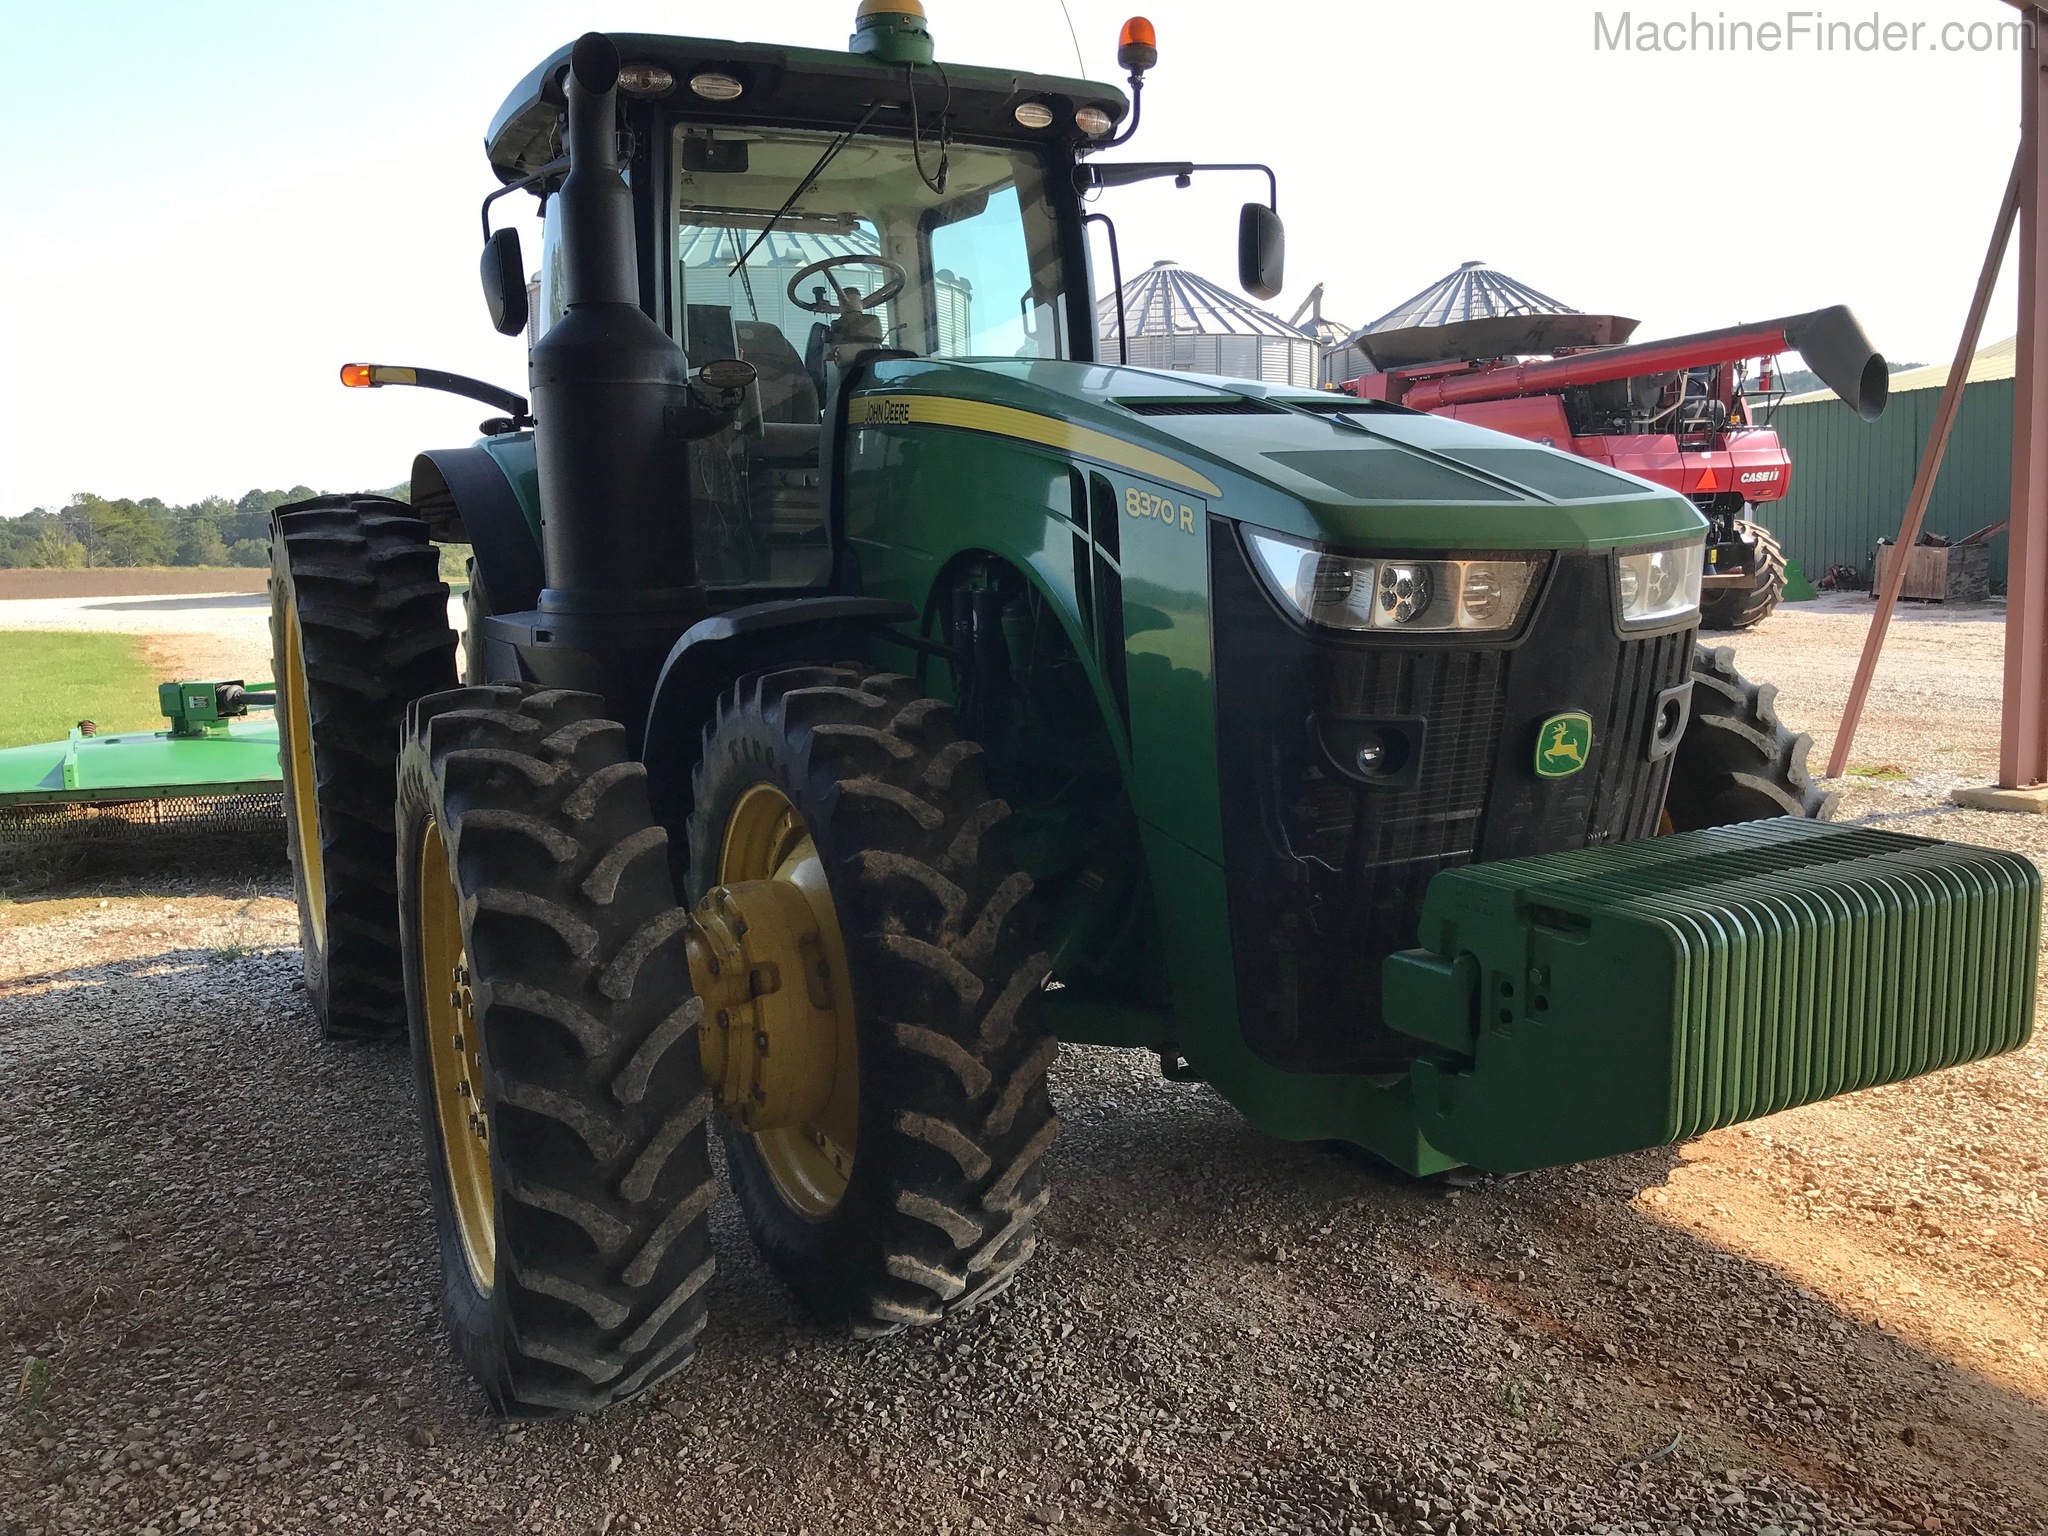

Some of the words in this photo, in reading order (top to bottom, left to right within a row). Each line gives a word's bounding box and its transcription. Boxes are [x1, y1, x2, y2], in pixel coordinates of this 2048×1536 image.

[864, 400, 884, 423] JOHN
[884, 399, 910, 423] DEERE
[1740, 471, 1770, 483] CASE
[1125, 486, 1175, 525] 8370
[1179, 504, 1196, 535] R
